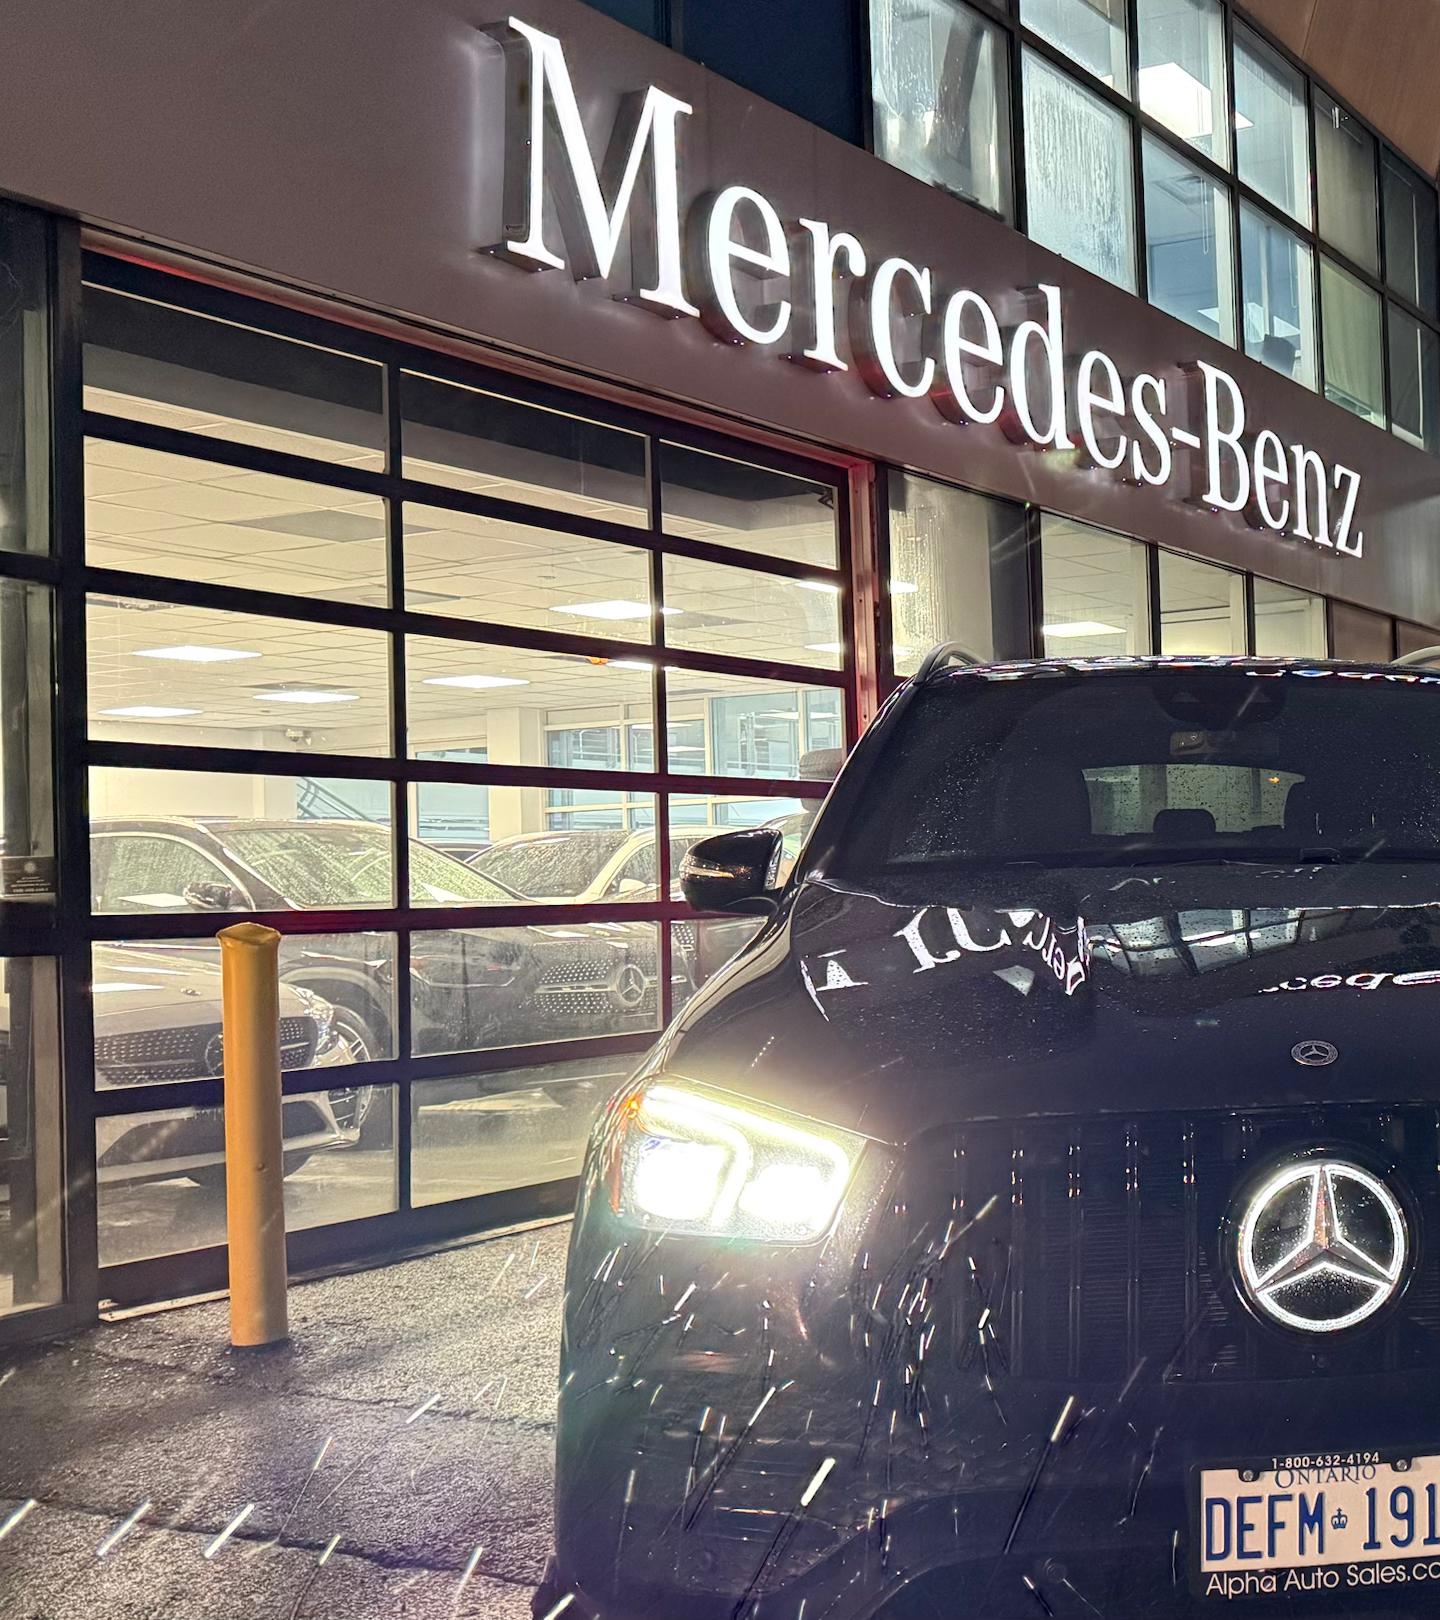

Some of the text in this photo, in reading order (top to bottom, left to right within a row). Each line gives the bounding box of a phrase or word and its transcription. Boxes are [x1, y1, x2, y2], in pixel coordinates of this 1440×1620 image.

[506, 15, 1364, 558] Mercedes-Benz
[1272, 1451, 1380, 1470] 1-800-632-4194
[1274, 1464, 1377, 1489] ONTARIO
[1204, 1492, 1325, 1561] DEFM
[1205, 1572, 1277, 1599] Alpha
[1283, 1567, 1340, 1591] Auto
